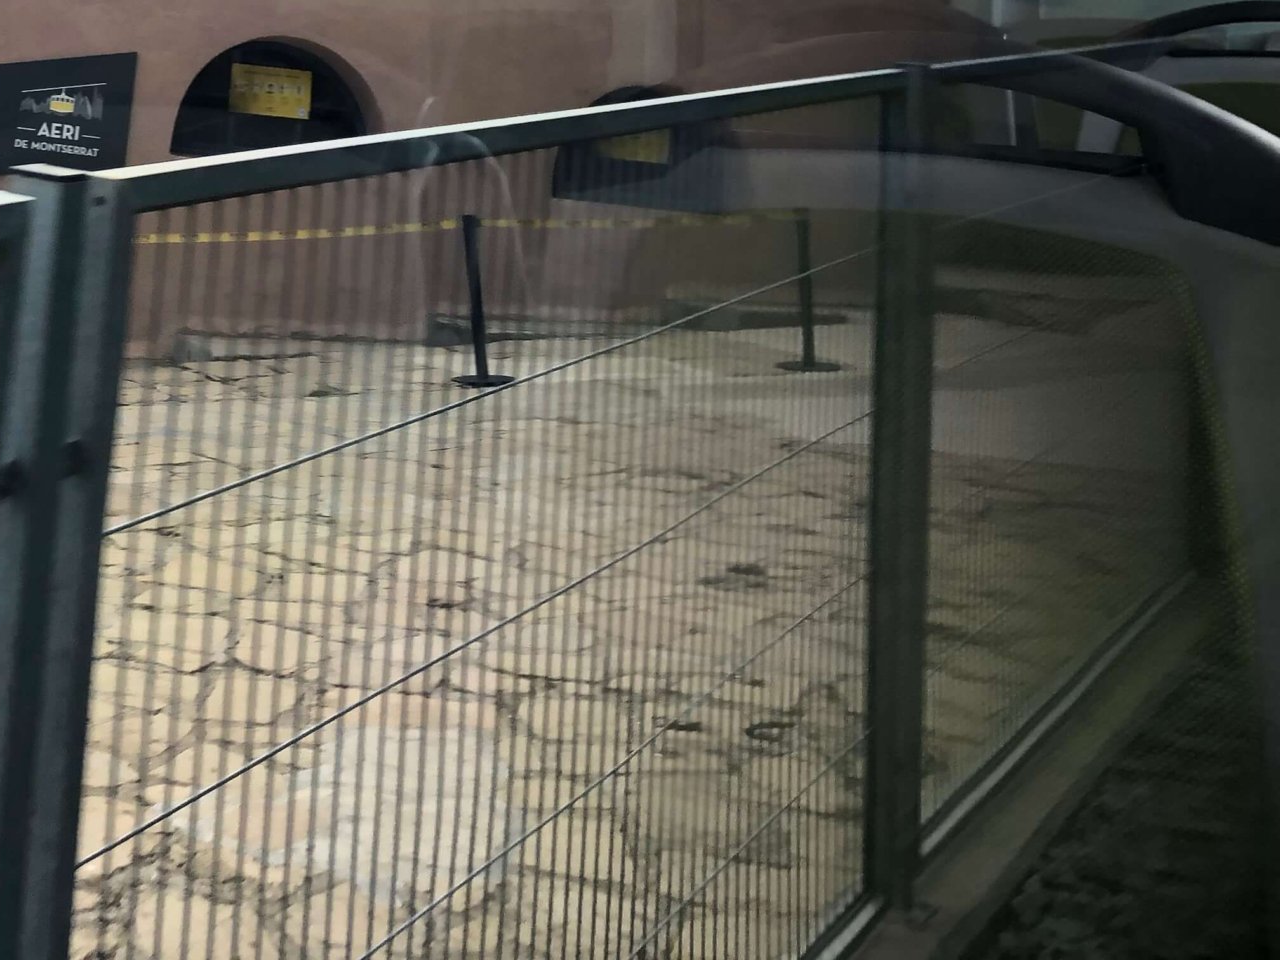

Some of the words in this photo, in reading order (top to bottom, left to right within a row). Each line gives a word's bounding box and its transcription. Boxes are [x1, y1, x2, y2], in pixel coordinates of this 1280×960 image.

[37, 122, 80, 140] AERI
[14, 139, 29, 149] DE
[30, 141, 100, 157] MONTSERRAT
